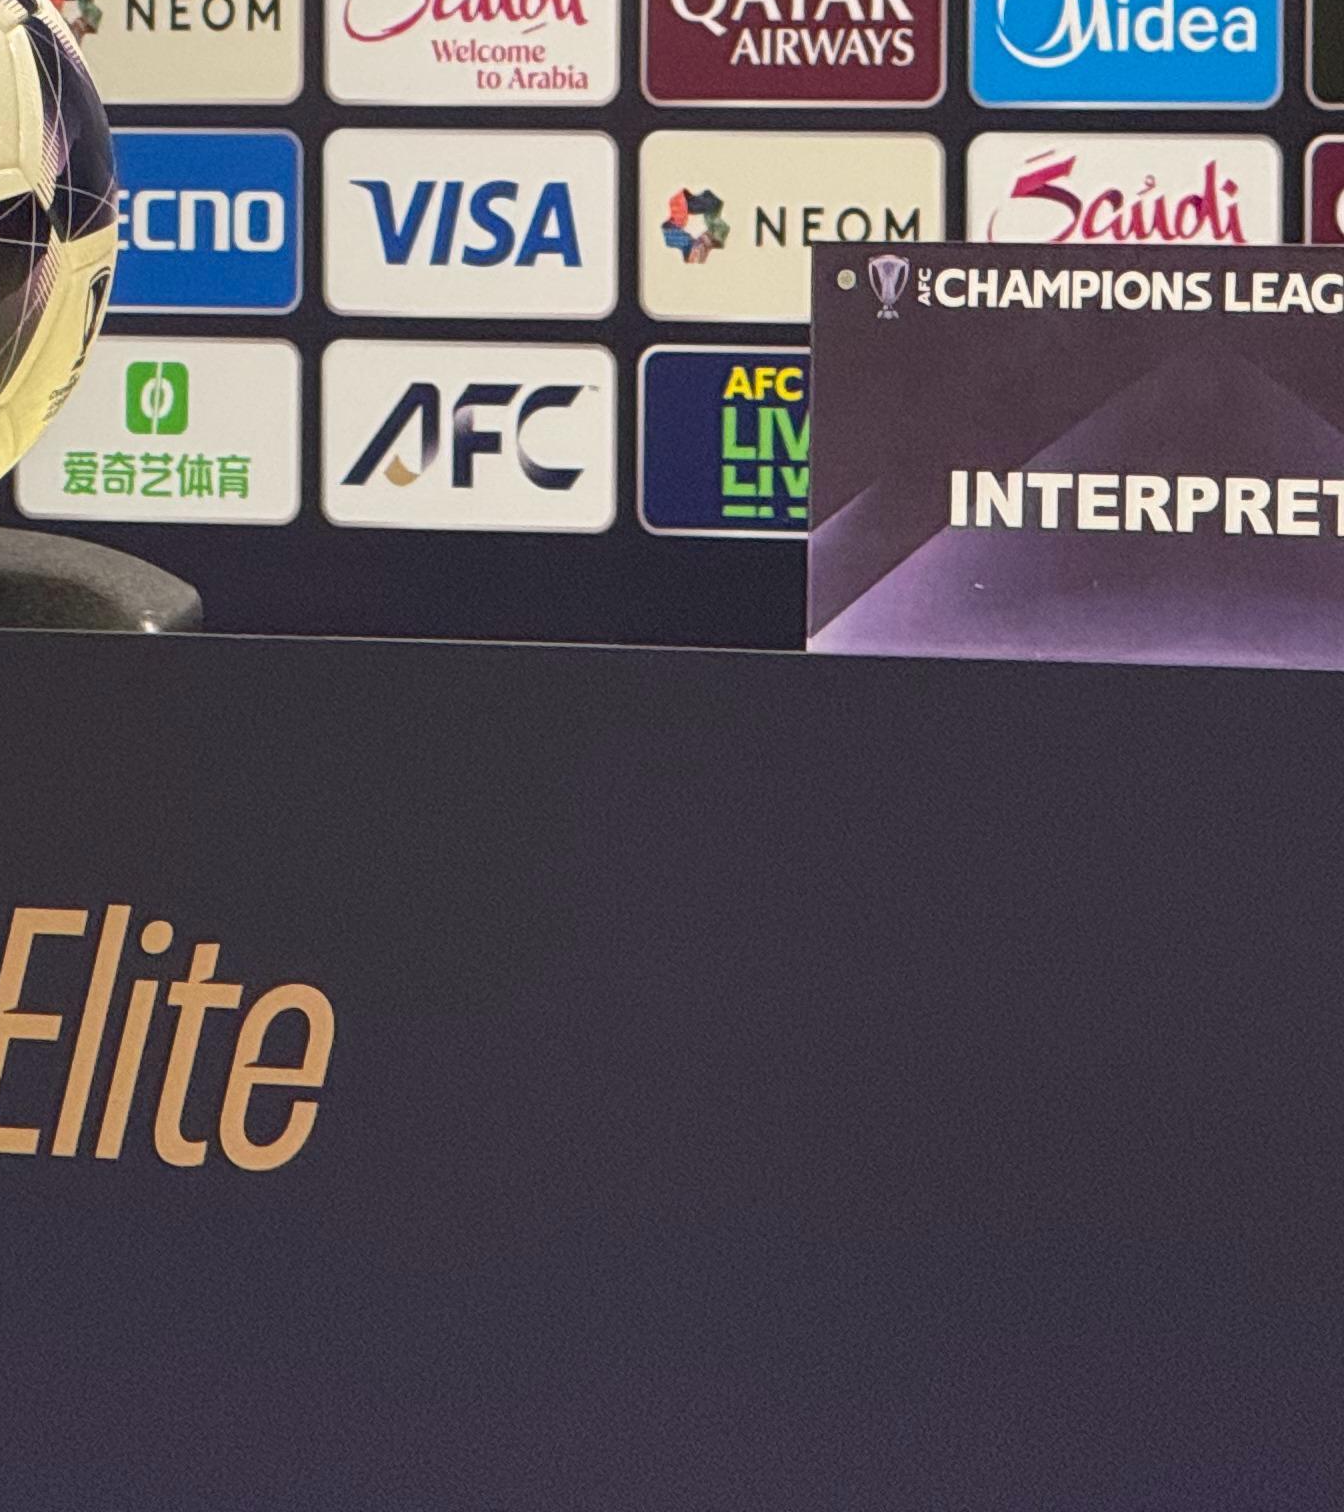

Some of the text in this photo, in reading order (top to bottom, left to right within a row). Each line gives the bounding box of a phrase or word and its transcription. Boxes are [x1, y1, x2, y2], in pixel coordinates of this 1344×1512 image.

[432, 40, 547, 64] Welcome
[731, 28, 916, 67] AIRWAYS
[477, 66, 589, 90] to Arabia
[987, 150, 1247, 243] Saudi
[118, 190, 285, 252] CNO
[349, 180, 583, 268] VISA
[755, 205, 921, 246] NEOM
[917, 267, 933, 306] AFC
[934, 268, 1344, 315] CHAMPIONS LEAG
[723, 366, 804, 402] AFC
[340, 382, 588, 491] AFC
[722, 406, 810, 461] LIV
[63, 452, 252, 500] 爱奇艺体育
